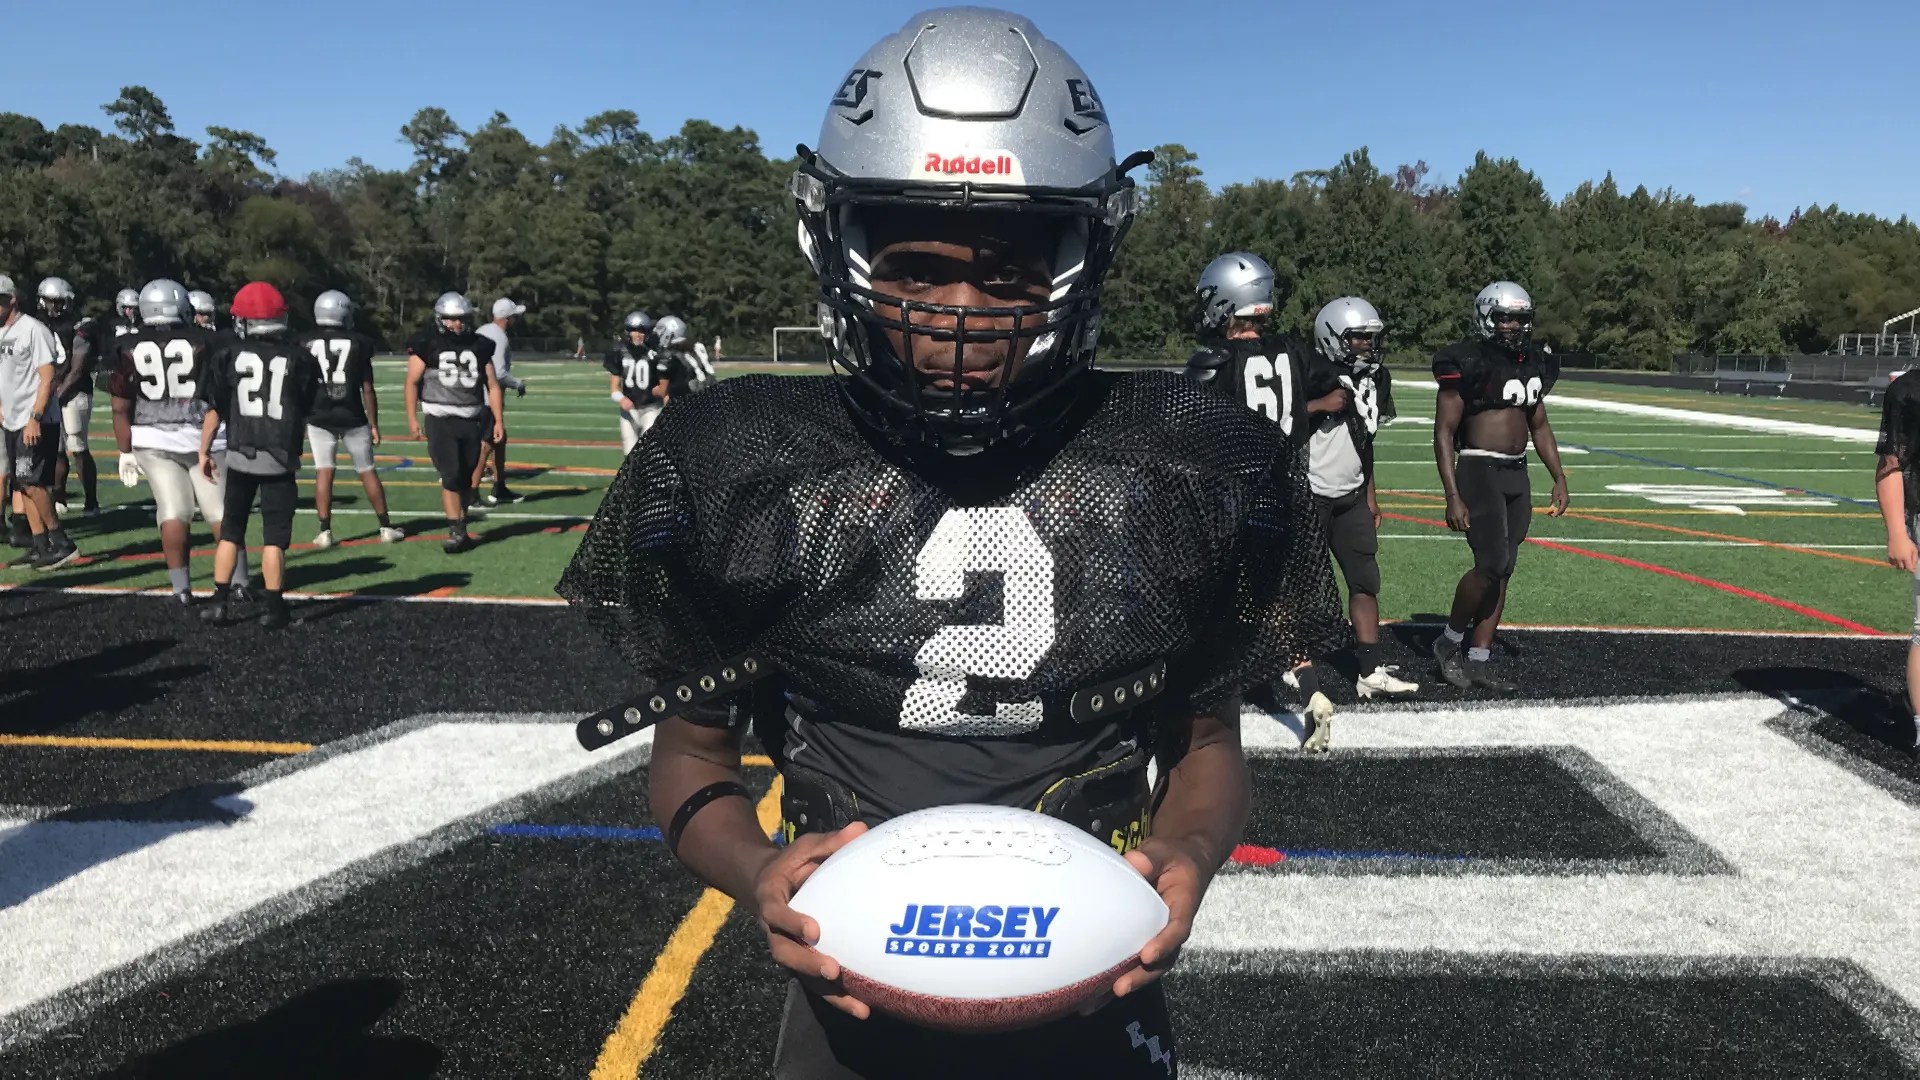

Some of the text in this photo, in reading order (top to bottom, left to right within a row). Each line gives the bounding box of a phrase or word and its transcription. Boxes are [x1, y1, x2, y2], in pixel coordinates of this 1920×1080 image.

[924, 152, 1012, 176] Riddell
[133, 338, 197, 400] 92
[235, 351, 287, 420] 21
[438, 350, 479, 388] 53
[622, 358, 650, 390] 70
[1244, 353, 1293, 436] 61
[899, 507, 1056, 736] 2
[889, 903, 1061, 938] JERSEY
[889, 940, 1046, 956] SPORTS ZONE
